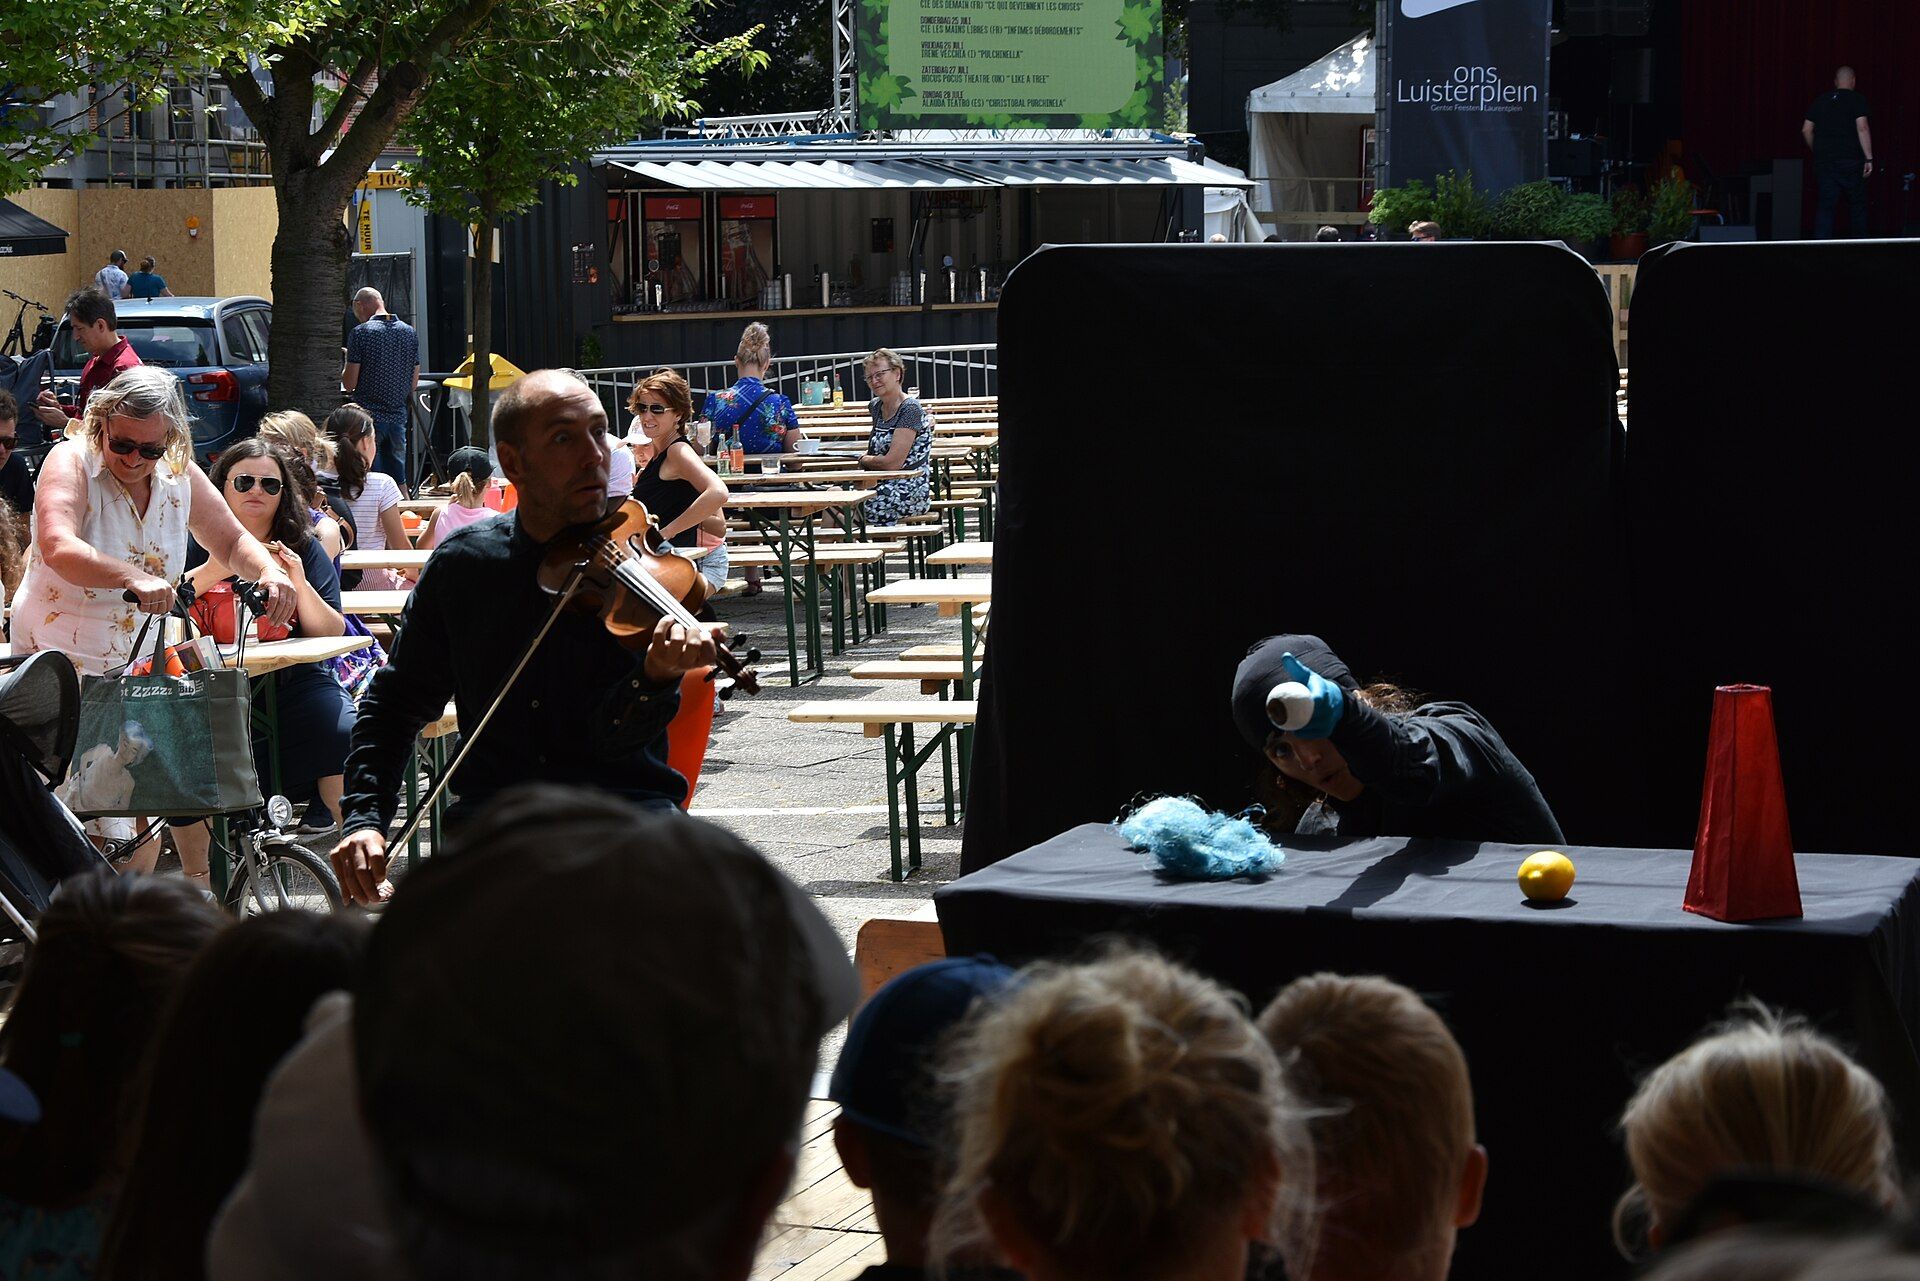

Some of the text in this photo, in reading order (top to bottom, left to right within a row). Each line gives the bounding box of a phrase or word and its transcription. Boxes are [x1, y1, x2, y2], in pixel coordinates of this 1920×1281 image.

[1046, 2, 1056, 11] LES
[932, 25, 943, 33] LES
[945, 25, 965, 33] MAINS
[964, 75, 990, 83] THEATRE
[1454, 66, 1498, 83] ons
[1398, 79, 1537, 110] Luisterplein
[1484, 104, 1522, 112] Laurentplein
[363, 209, 370, 221] TE
